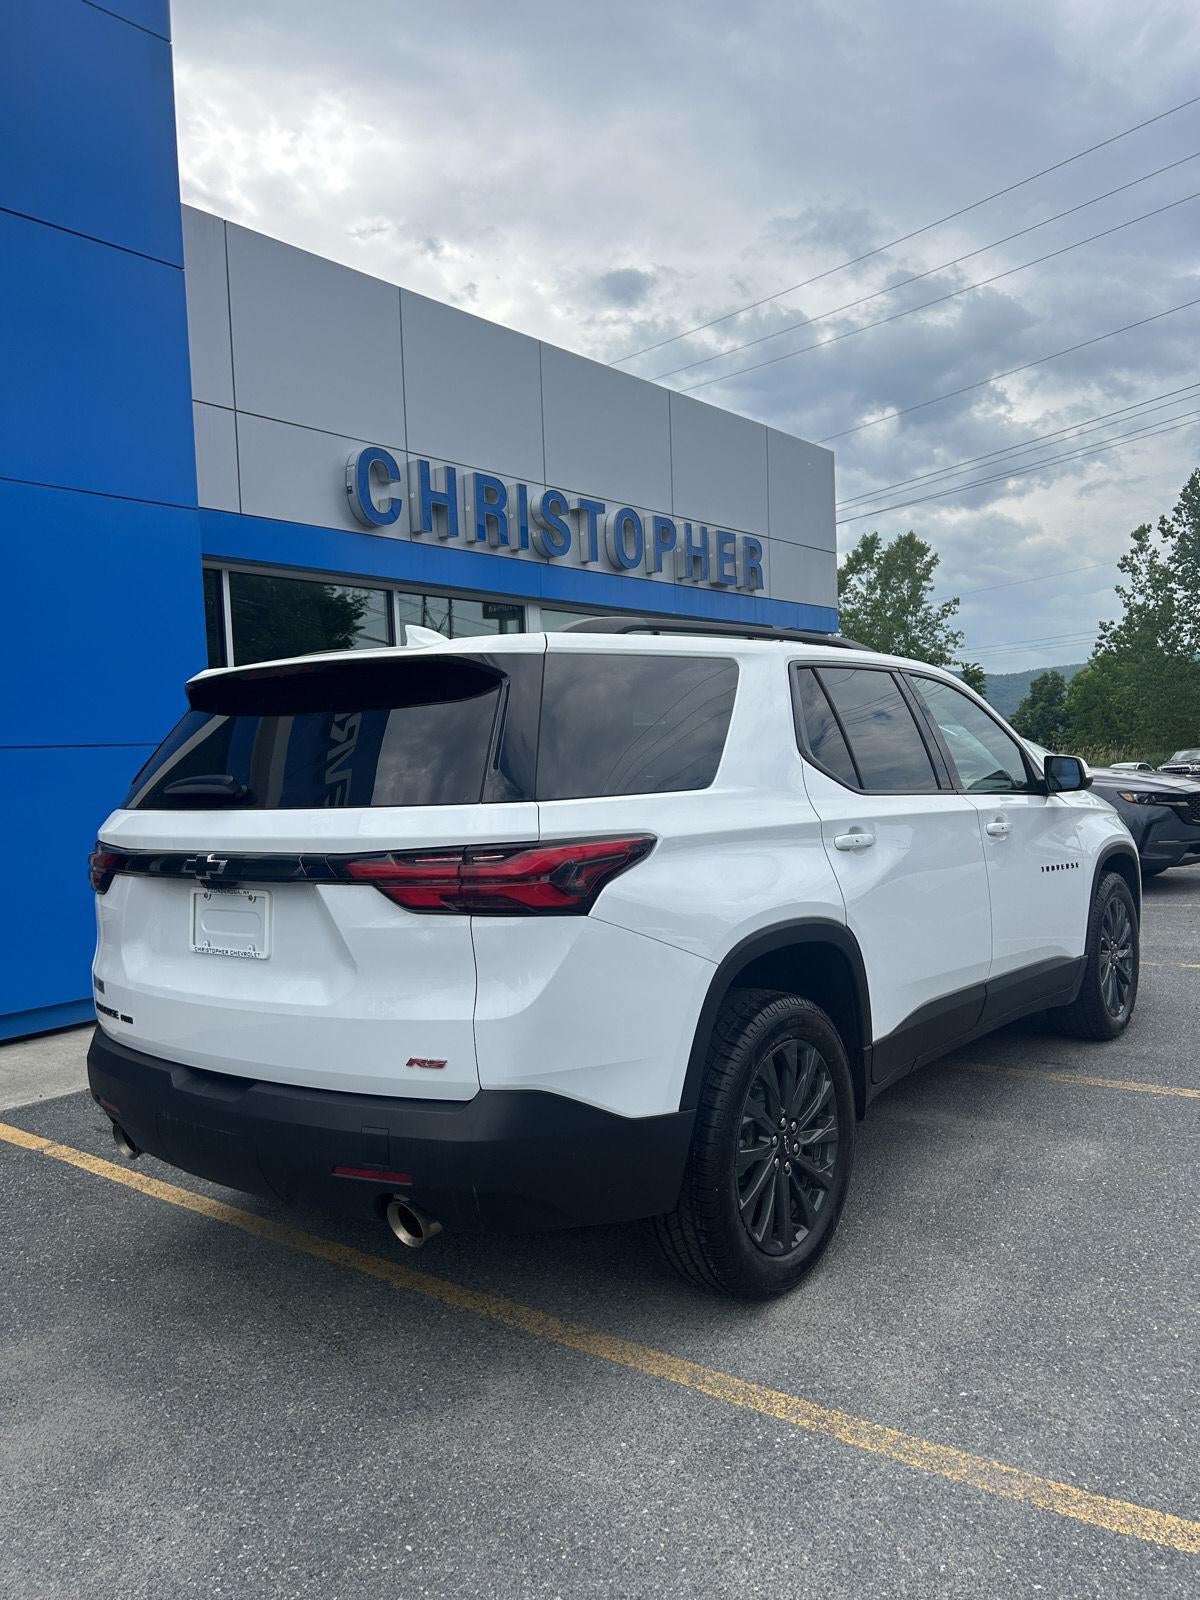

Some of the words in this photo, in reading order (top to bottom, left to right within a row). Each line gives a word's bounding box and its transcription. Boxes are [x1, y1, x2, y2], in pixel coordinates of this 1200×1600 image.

[346, 446, 764, 590] CHRISTOPHER
[194, 946, 229, 955] CHRISTOPHER
[406, 1057, 447, 1069] RS
